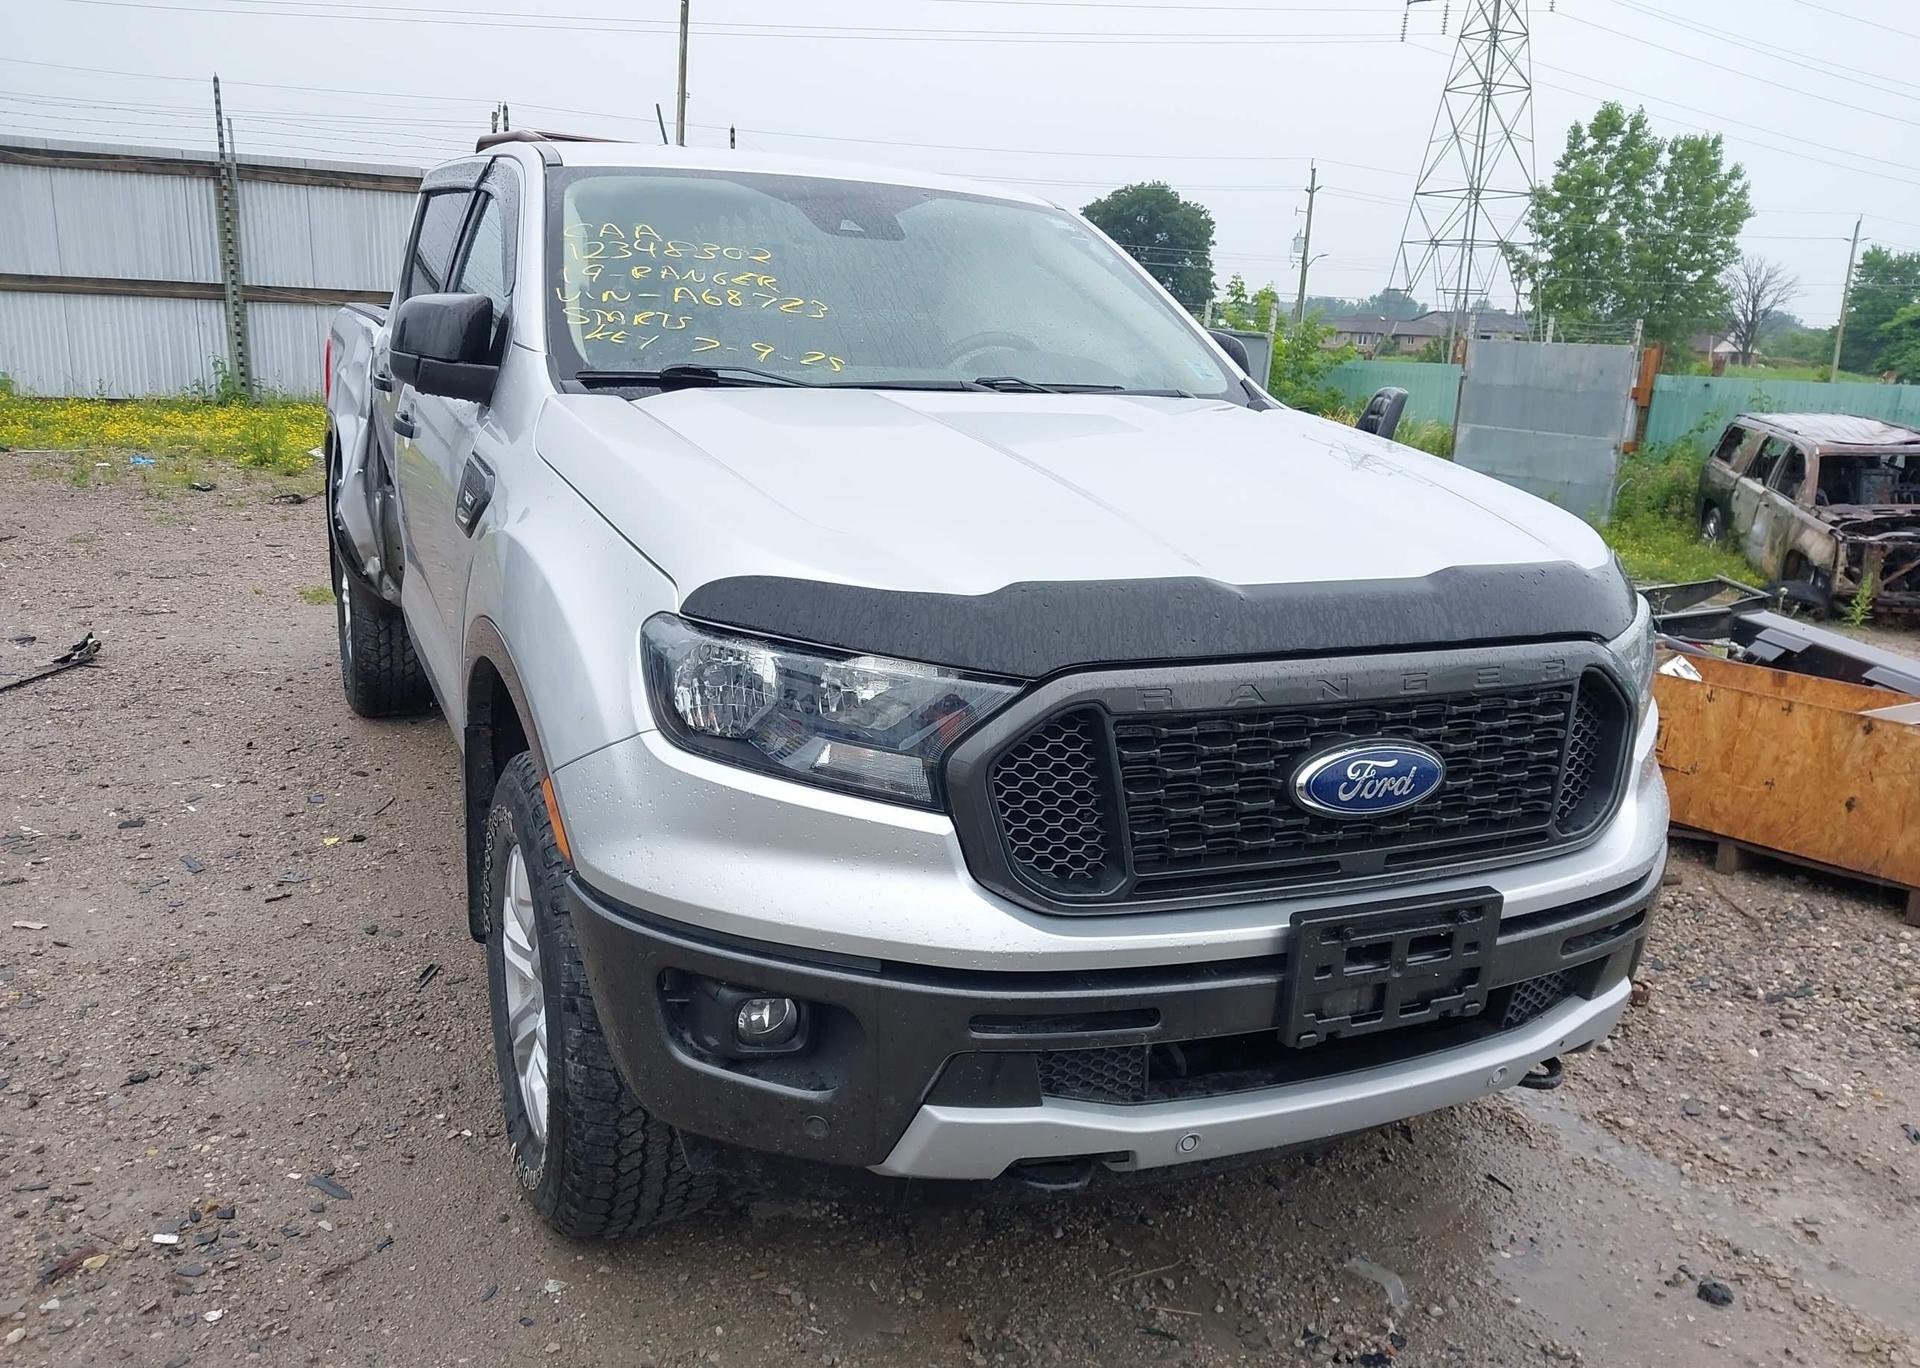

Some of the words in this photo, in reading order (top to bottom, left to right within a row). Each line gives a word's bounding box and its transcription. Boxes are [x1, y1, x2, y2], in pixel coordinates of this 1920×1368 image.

[563, 222, 663, 242] CAA
[568, 240, 772, 265] 12348302
[583, 323, 660, 351] KEY
[1135, 658, 1568, 710] RANGER
[1337, 757, 1418, 801] Ford
